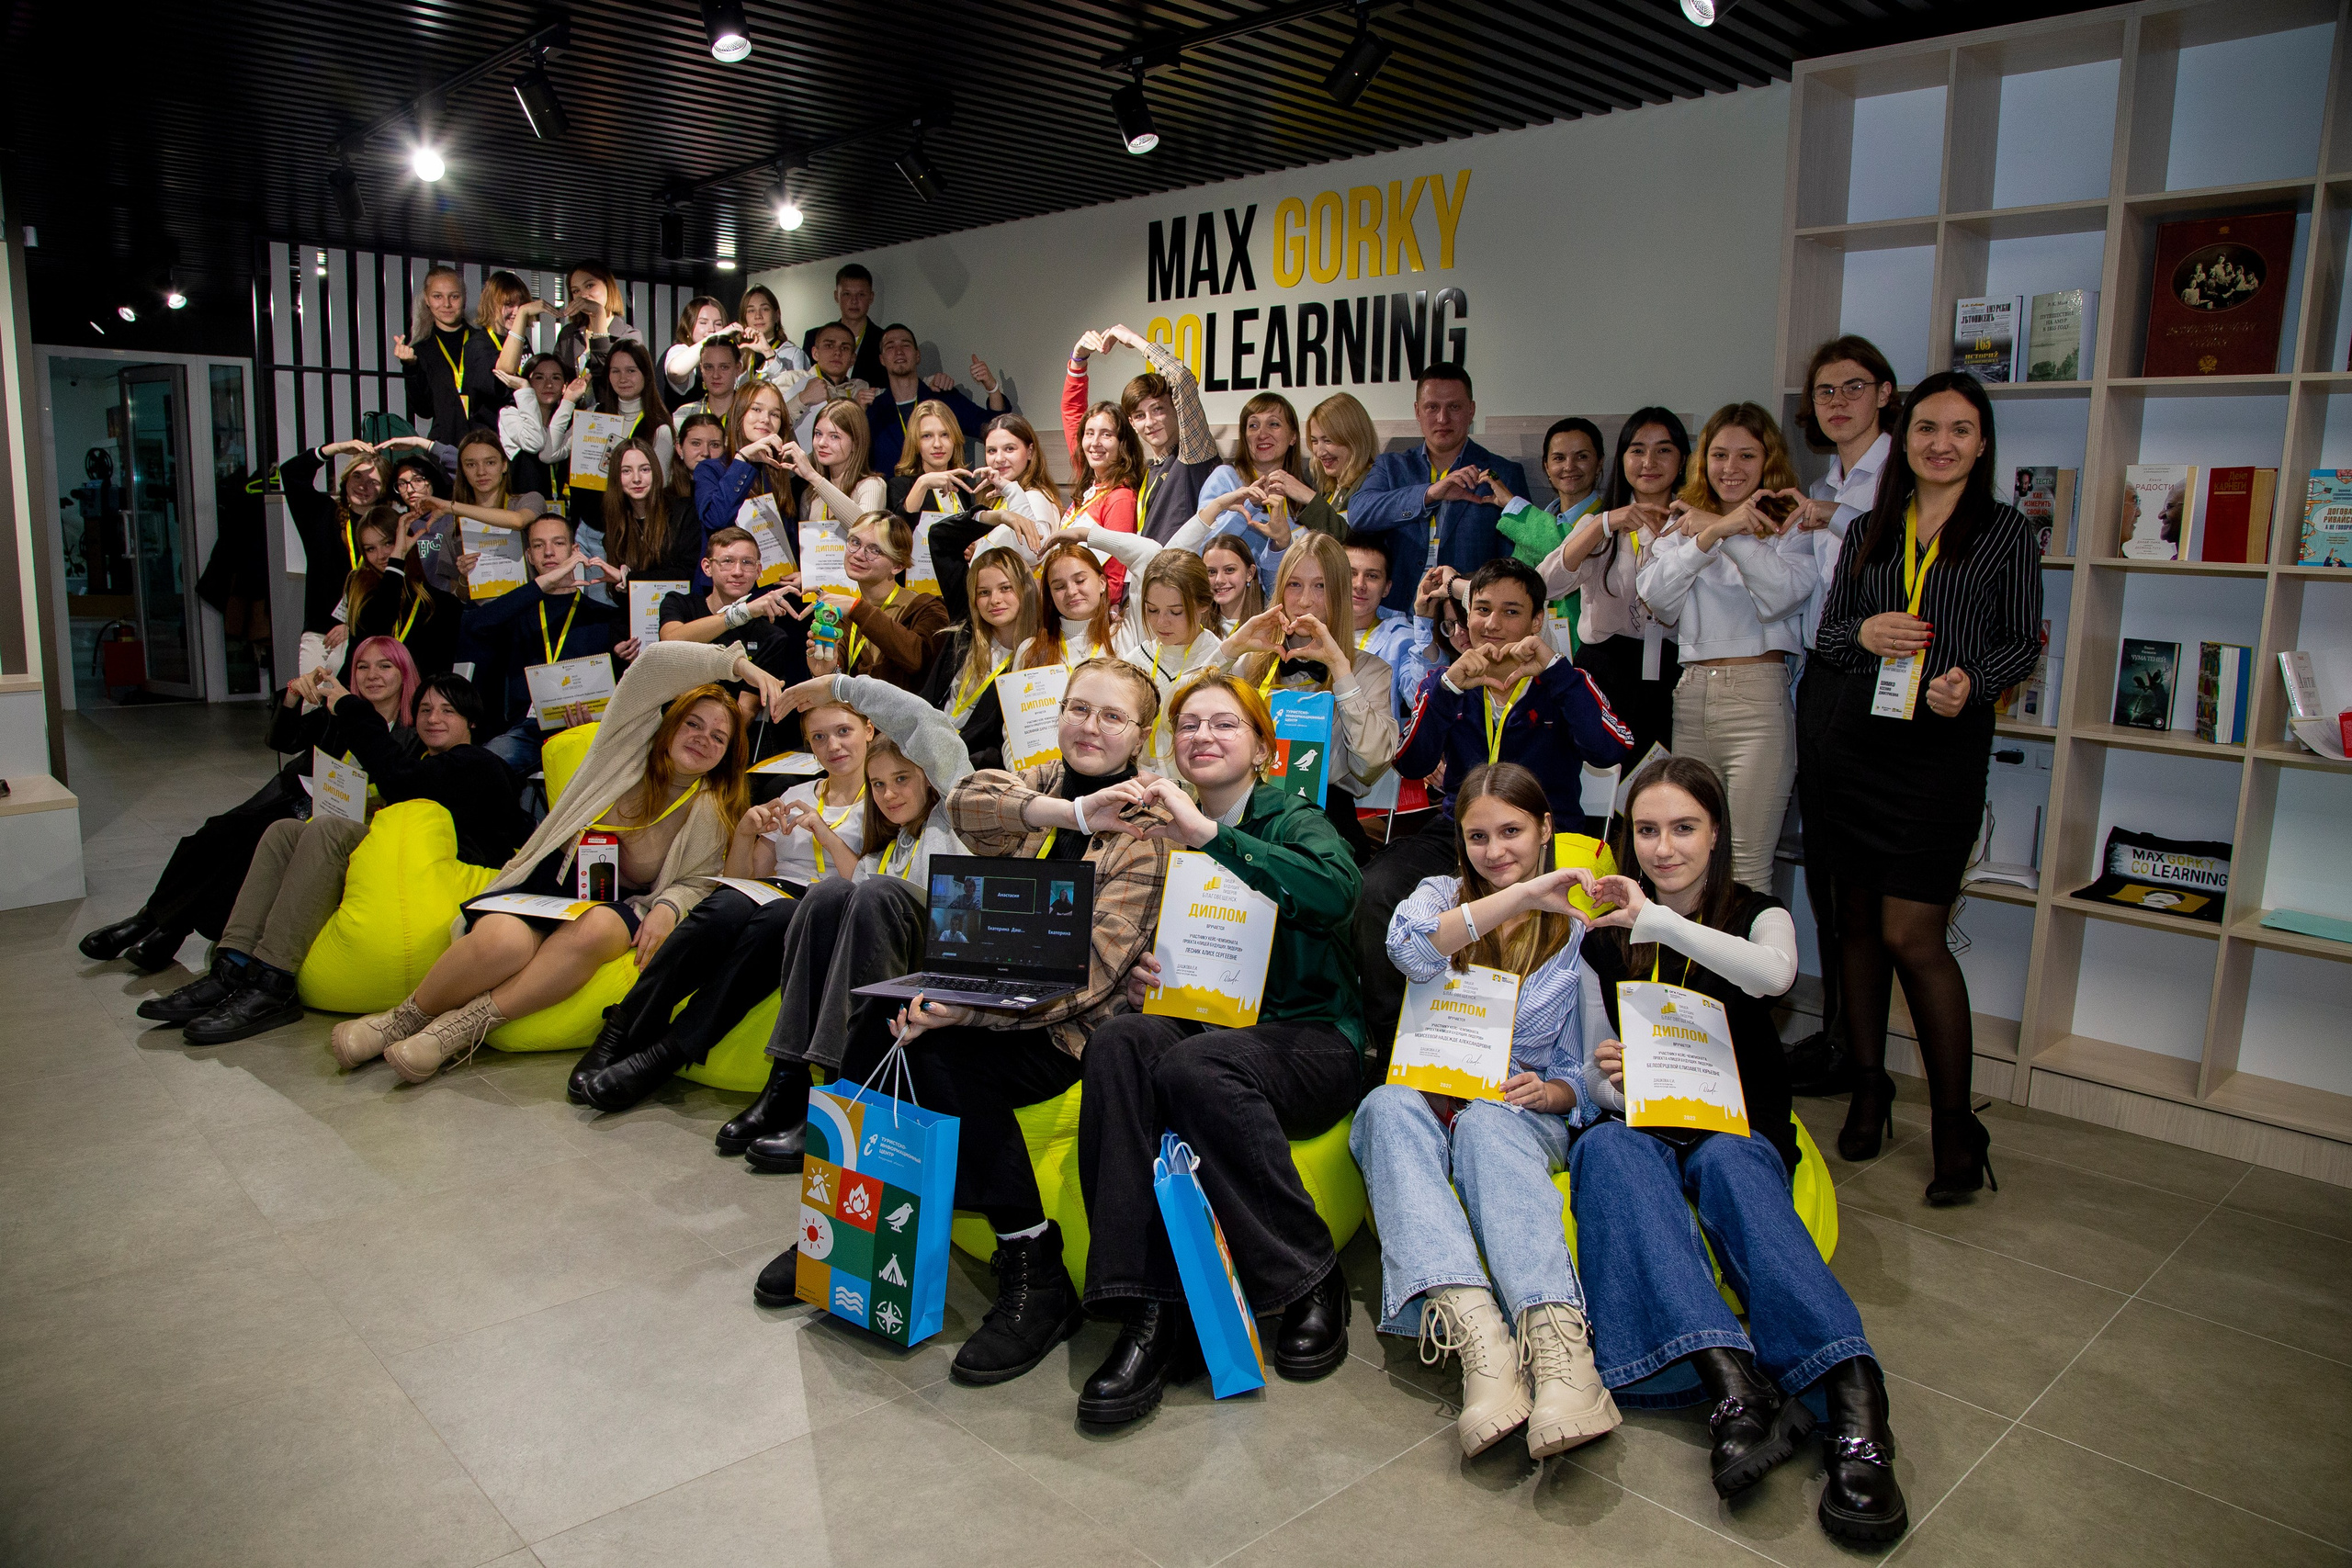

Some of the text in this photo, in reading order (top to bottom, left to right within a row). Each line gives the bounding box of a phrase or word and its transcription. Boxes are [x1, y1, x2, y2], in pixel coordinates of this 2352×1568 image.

[1148, 169, 1472, 303] MAX GORKY
[1974, 336, 1992, 350] 165
[2229, 471, 2248, 481] Дейл
[2214, 482, 2247, 491] КАРНЕГИ
[2147, 655, 2166, 663] ТЕНЕЙ
[1021, 697, 1057, 713] ДИПЛОМ
[323, 783, 349, 802] ДИПЛОМ
[2132, 849, 2216, 871] MAX GORKY
[2131, 861, 2228, 886] CO LEARNING
[1202, 893, 1238, 902] БЛАГОВЕЩЕНСК
[1188, 903, 1248, 924] ДИПЛОМ
[1185, 947, 1238, 961] ЛЕСНИК АЛИСЕ СЕРГЕЕВНЕ
[1442, 991, 1476, 1000] БЛАГОВЕЩЕНСК
[1430, 999, 1487, 1018] ДИПЛОМ
[1661, 1015, 1695, 1025] БЛАГОВЕЩЕНСК
[1652, 1024, 1709, 1043] ДИПЛОМ
[1438, 1034, 1458, 1043] НАДЕЖДЕ
[1459, 1038, 1492, 1050] АЛЕКСАНДРОВНЕ
[1679, 1065, 1702, 1073] ЕЛИЗАВЕТЕ
[1702, 1068, 1720, 1077] ЮРЬЕВНЕ
[879, 1149, 894, 1157] ЦЕНТР
[880, 1143, 922, 1164] ИНФОРМАЦИОННЫЙ
